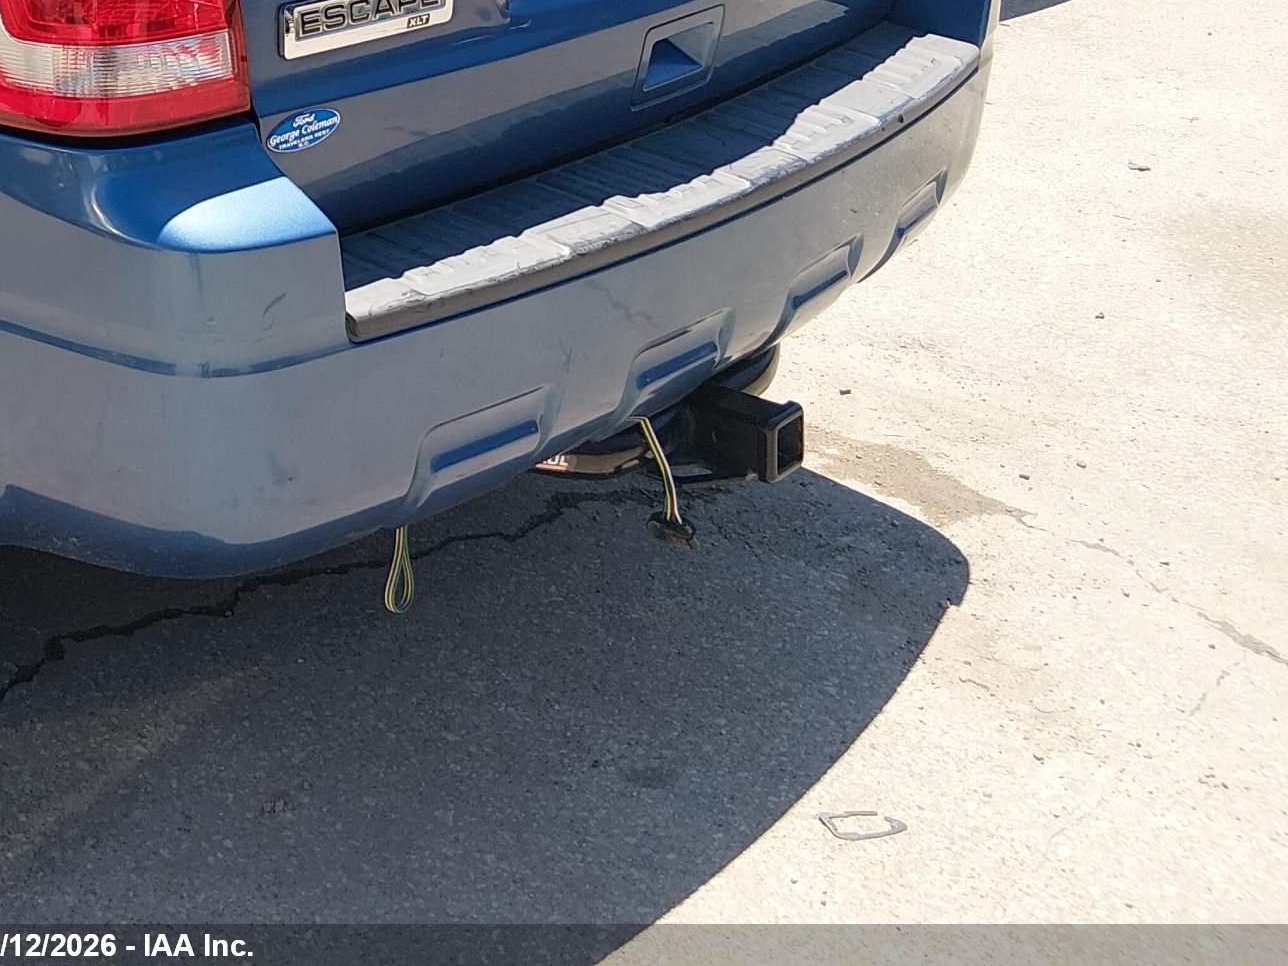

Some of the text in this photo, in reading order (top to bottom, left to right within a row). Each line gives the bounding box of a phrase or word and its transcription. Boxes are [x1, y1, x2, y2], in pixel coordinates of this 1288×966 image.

[409, 15, 429, 27] XLT
[292, 113, 316, 128] Ford
[270, 116, 338, 147] George Coleman
[314, 129, 330, 138] REST
